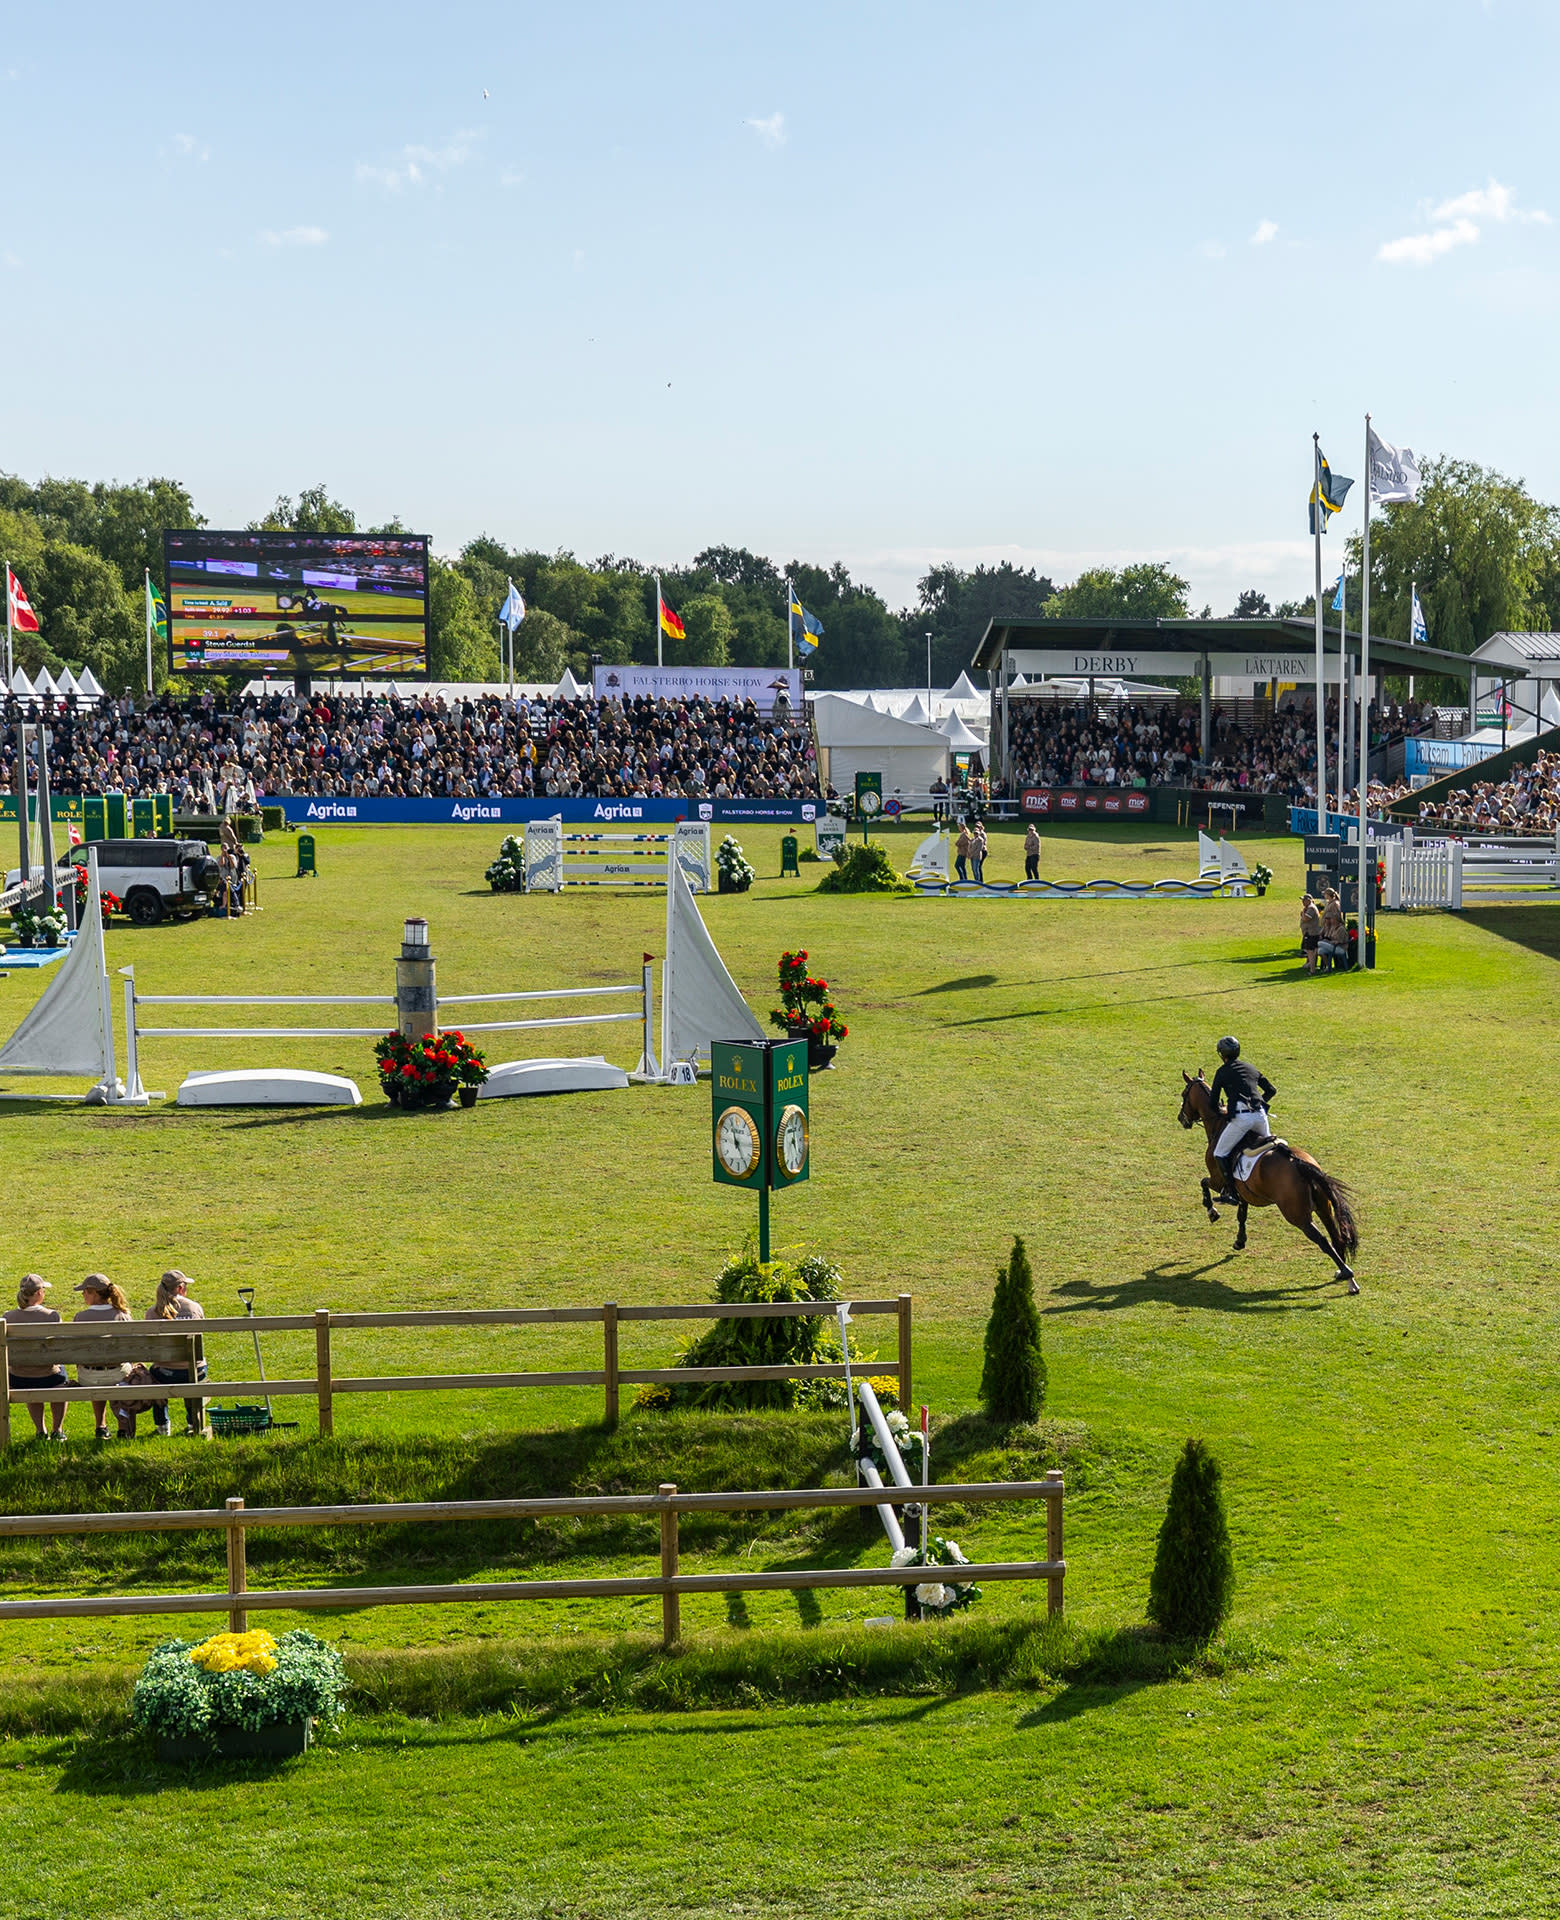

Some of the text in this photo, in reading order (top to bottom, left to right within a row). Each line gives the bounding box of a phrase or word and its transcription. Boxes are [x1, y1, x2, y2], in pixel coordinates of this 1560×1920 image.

[1074, 656, 1138, 672] DERBY
[1245, 655, 1307, 674] LÄKTAREN
[633, 676, 762, 686] FALSTERBO HORSE SHOW
[1415, 740, 1449, 766] Folksam
[307, 803, 346, 820] Agria
[451, 804, 492, 820] Agria
[594, 804, 632, 820] Agria
[678, 828, 699, 836] Agria
[605, 864, 625, 874] Agria
[682, 1067, 691, 1081] 18
[719, 1075, 756, 1092] ROLEX
[777, 1074, 804, 1092] ROLEX
